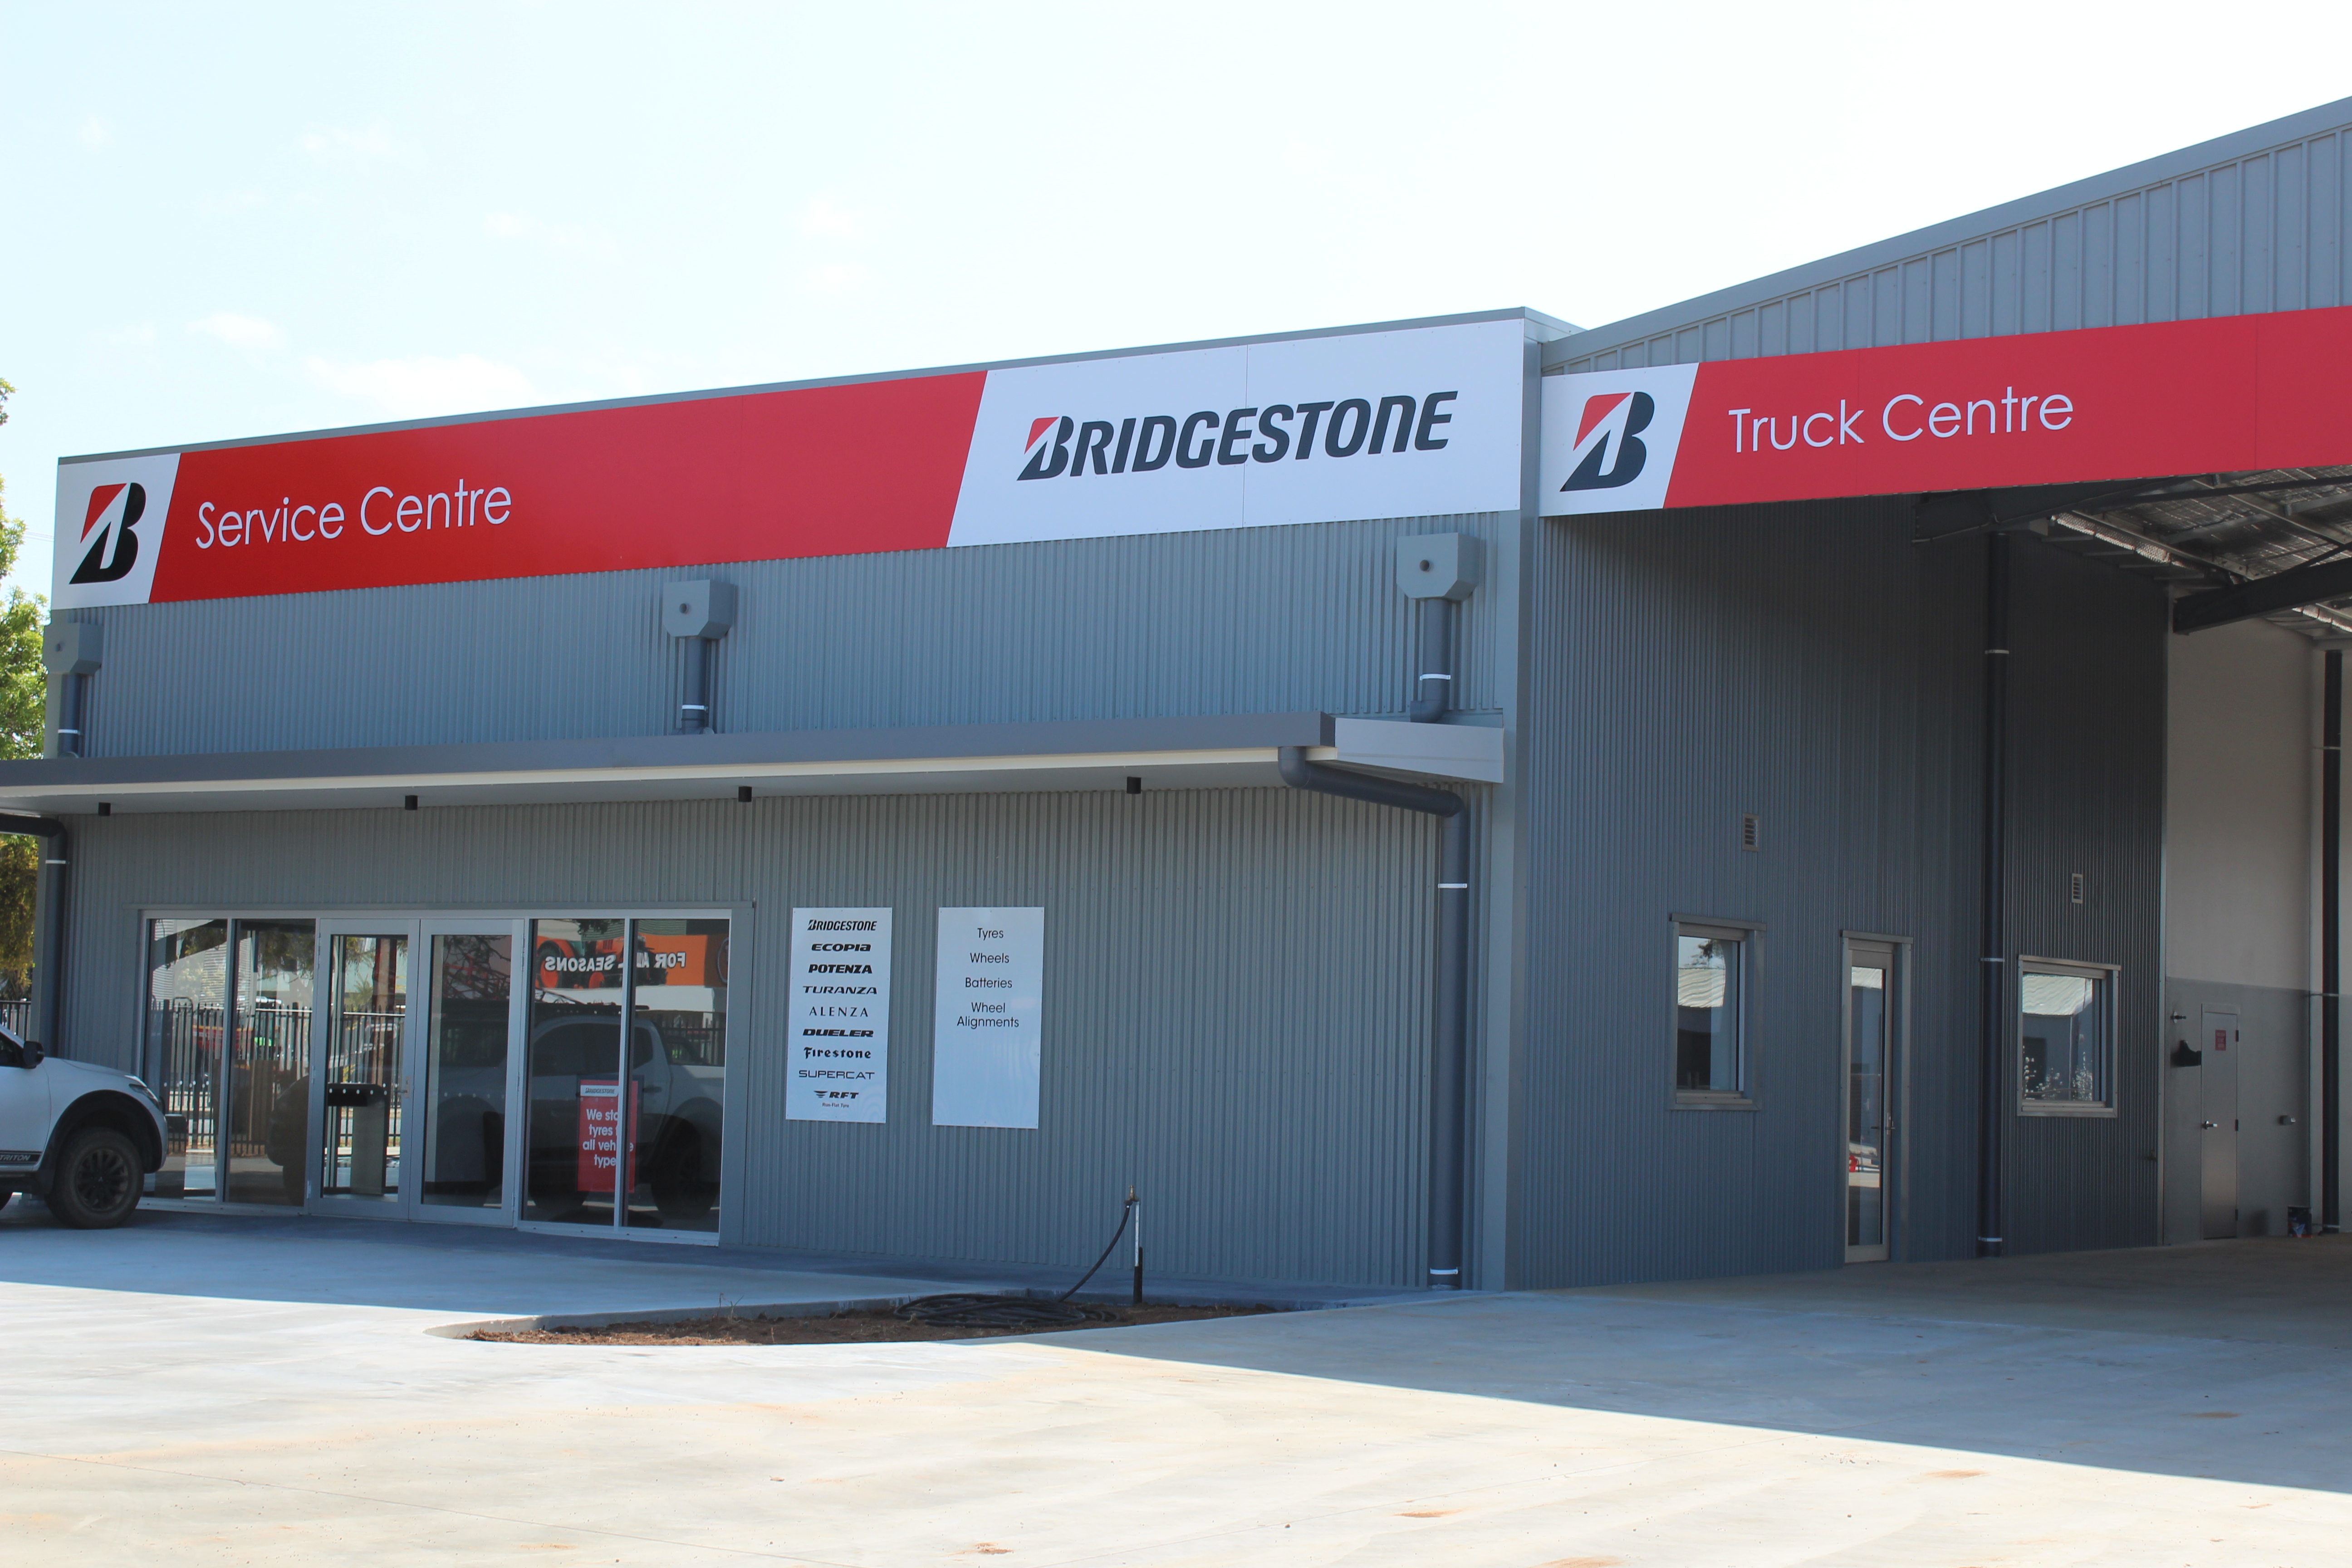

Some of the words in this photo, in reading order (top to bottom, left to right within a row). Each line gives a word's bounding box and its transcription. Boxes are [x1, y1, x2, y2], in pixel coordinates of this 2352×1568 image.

[1729, 400, 1865, 453] Truck
[1883, 387, 2074, 441] Centre
[1017, 391, 1459, 481] BRIDGESTONE
[196, 497, 345, 549] Service
[361, 479, 512, 536] Centre
[807, 919, 877, 931] BRIDGESTONE
[977, 928, 1004, 941] Tyres
[970, 953, 1009, 964] Wheels
[808, 964, 873, 974] POTENZA
[965, 977, 1013, 988] Batteries
[803, 985, 877, 995] TURANZA
[809, 1007, 869, 1017] ALENZA
[971, 1002, 1006, 1013] Wheel
[957, 1016, 1019, 1029] Alignments
[803, 1029, 874, 1038] DUELER
[804, 1047, 872, 1059] Firestone
[799, 1070, 875, 1080] SUPERCAT
[586, 1109, 603, 1121] We
[588, 1124, 613, 1138] tyres
[582, 1139, 595, 1150] all
[594, 1154, 617, 1168] type
